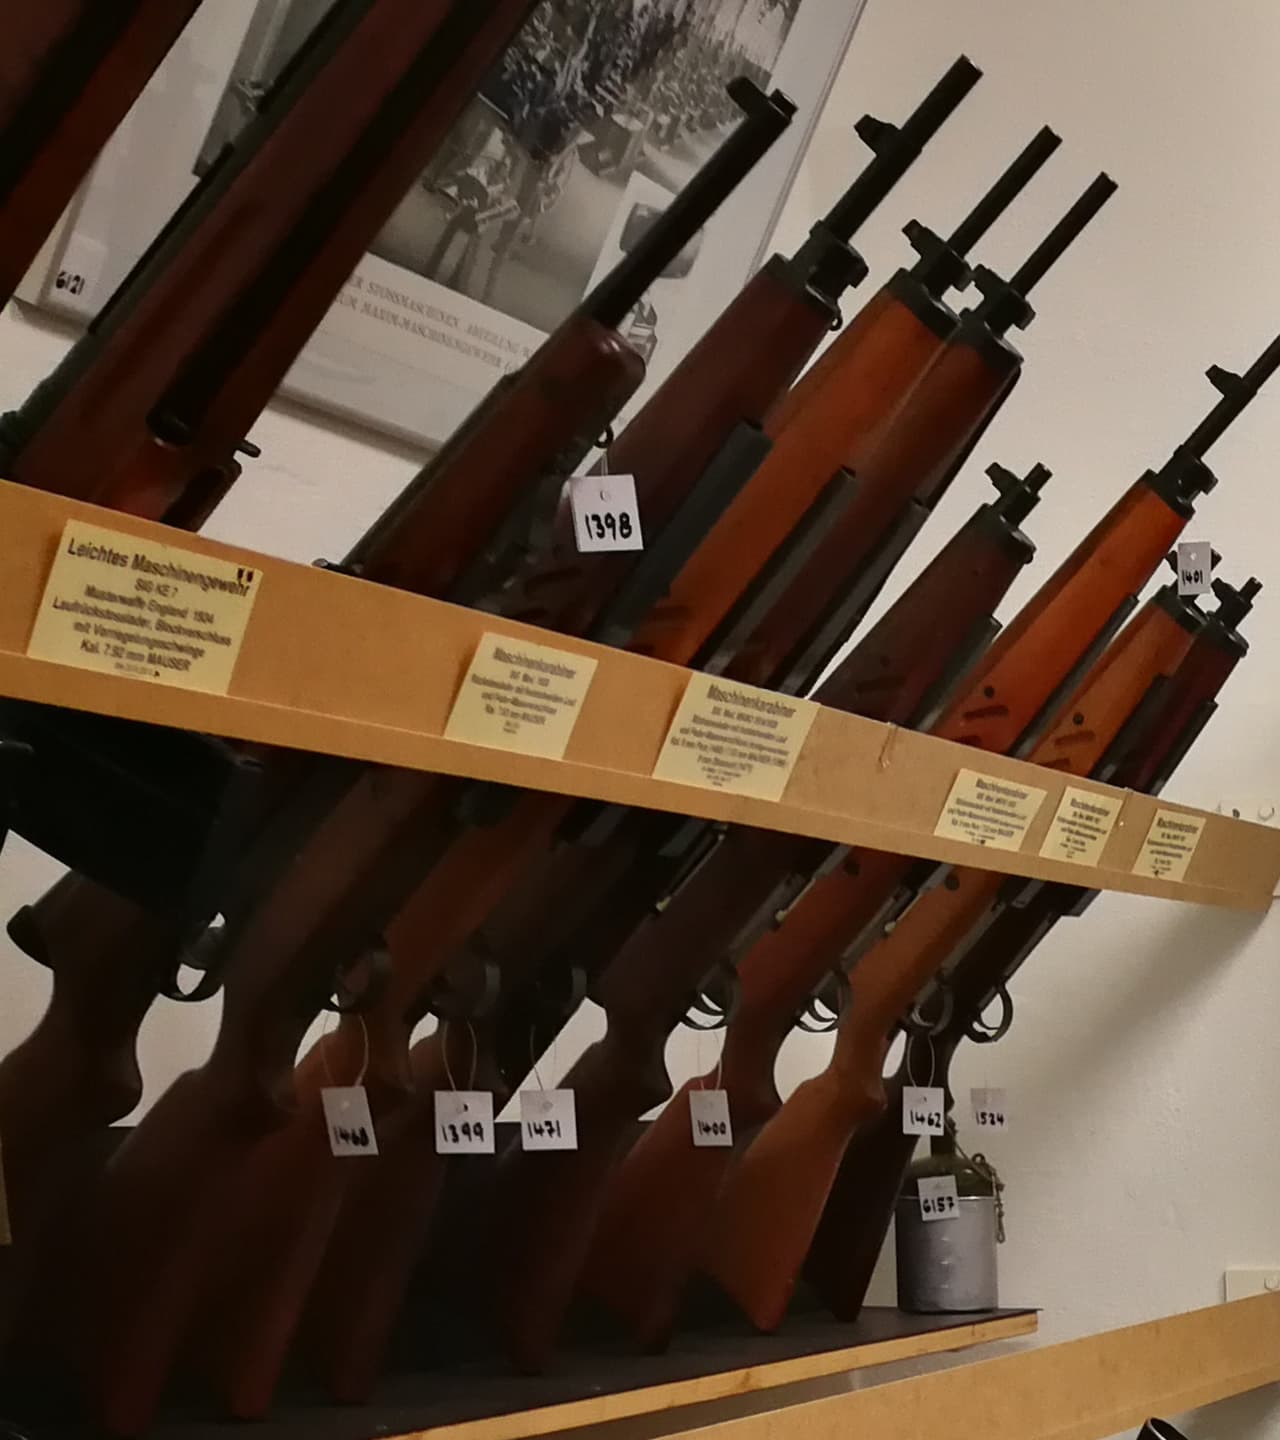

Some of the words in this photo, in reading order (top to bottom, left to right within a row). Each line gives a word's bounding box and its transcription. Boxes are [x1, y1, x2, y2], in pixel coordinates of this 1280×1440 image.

[585, 512, 633, 541] 1398
[67, 538, 129, 568] Leichtes
[131, 553, 251, 597] Maschinengewehr
[527, 1120, 563, 1140] 1471
[910, 1109, 942, 1129] 1462
[441, 1121, 485, 1144] 1399
